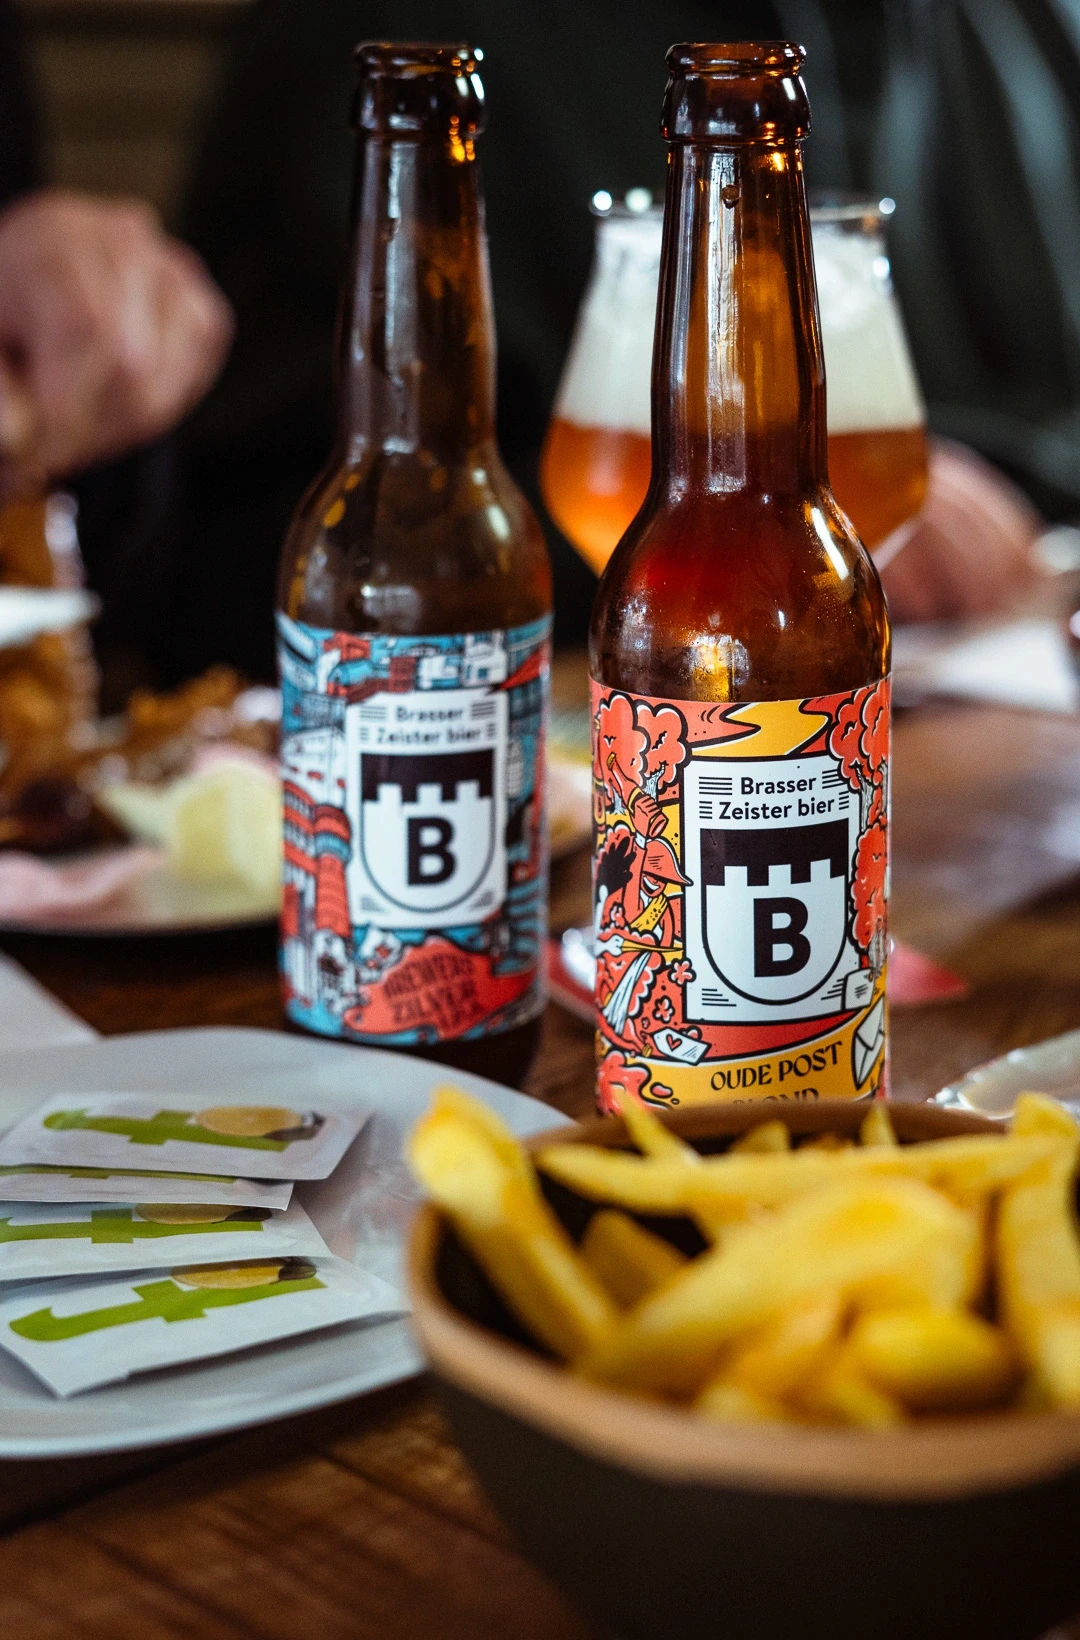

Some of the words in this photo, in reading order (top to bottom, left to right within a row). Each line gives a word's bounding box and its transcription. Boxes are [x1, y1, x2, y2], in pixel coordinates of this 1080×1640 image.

[718, 801, 793, 820] Zeister
[797, 797, 835, 817] bier
[740, 776, 817, 795] Brasser
[408, 816, 456, 886] B
[753, 897, 811, 977] B
[710, 1063, 773, 1091] OUDE
[778, 1040, 843, 1082] POST
